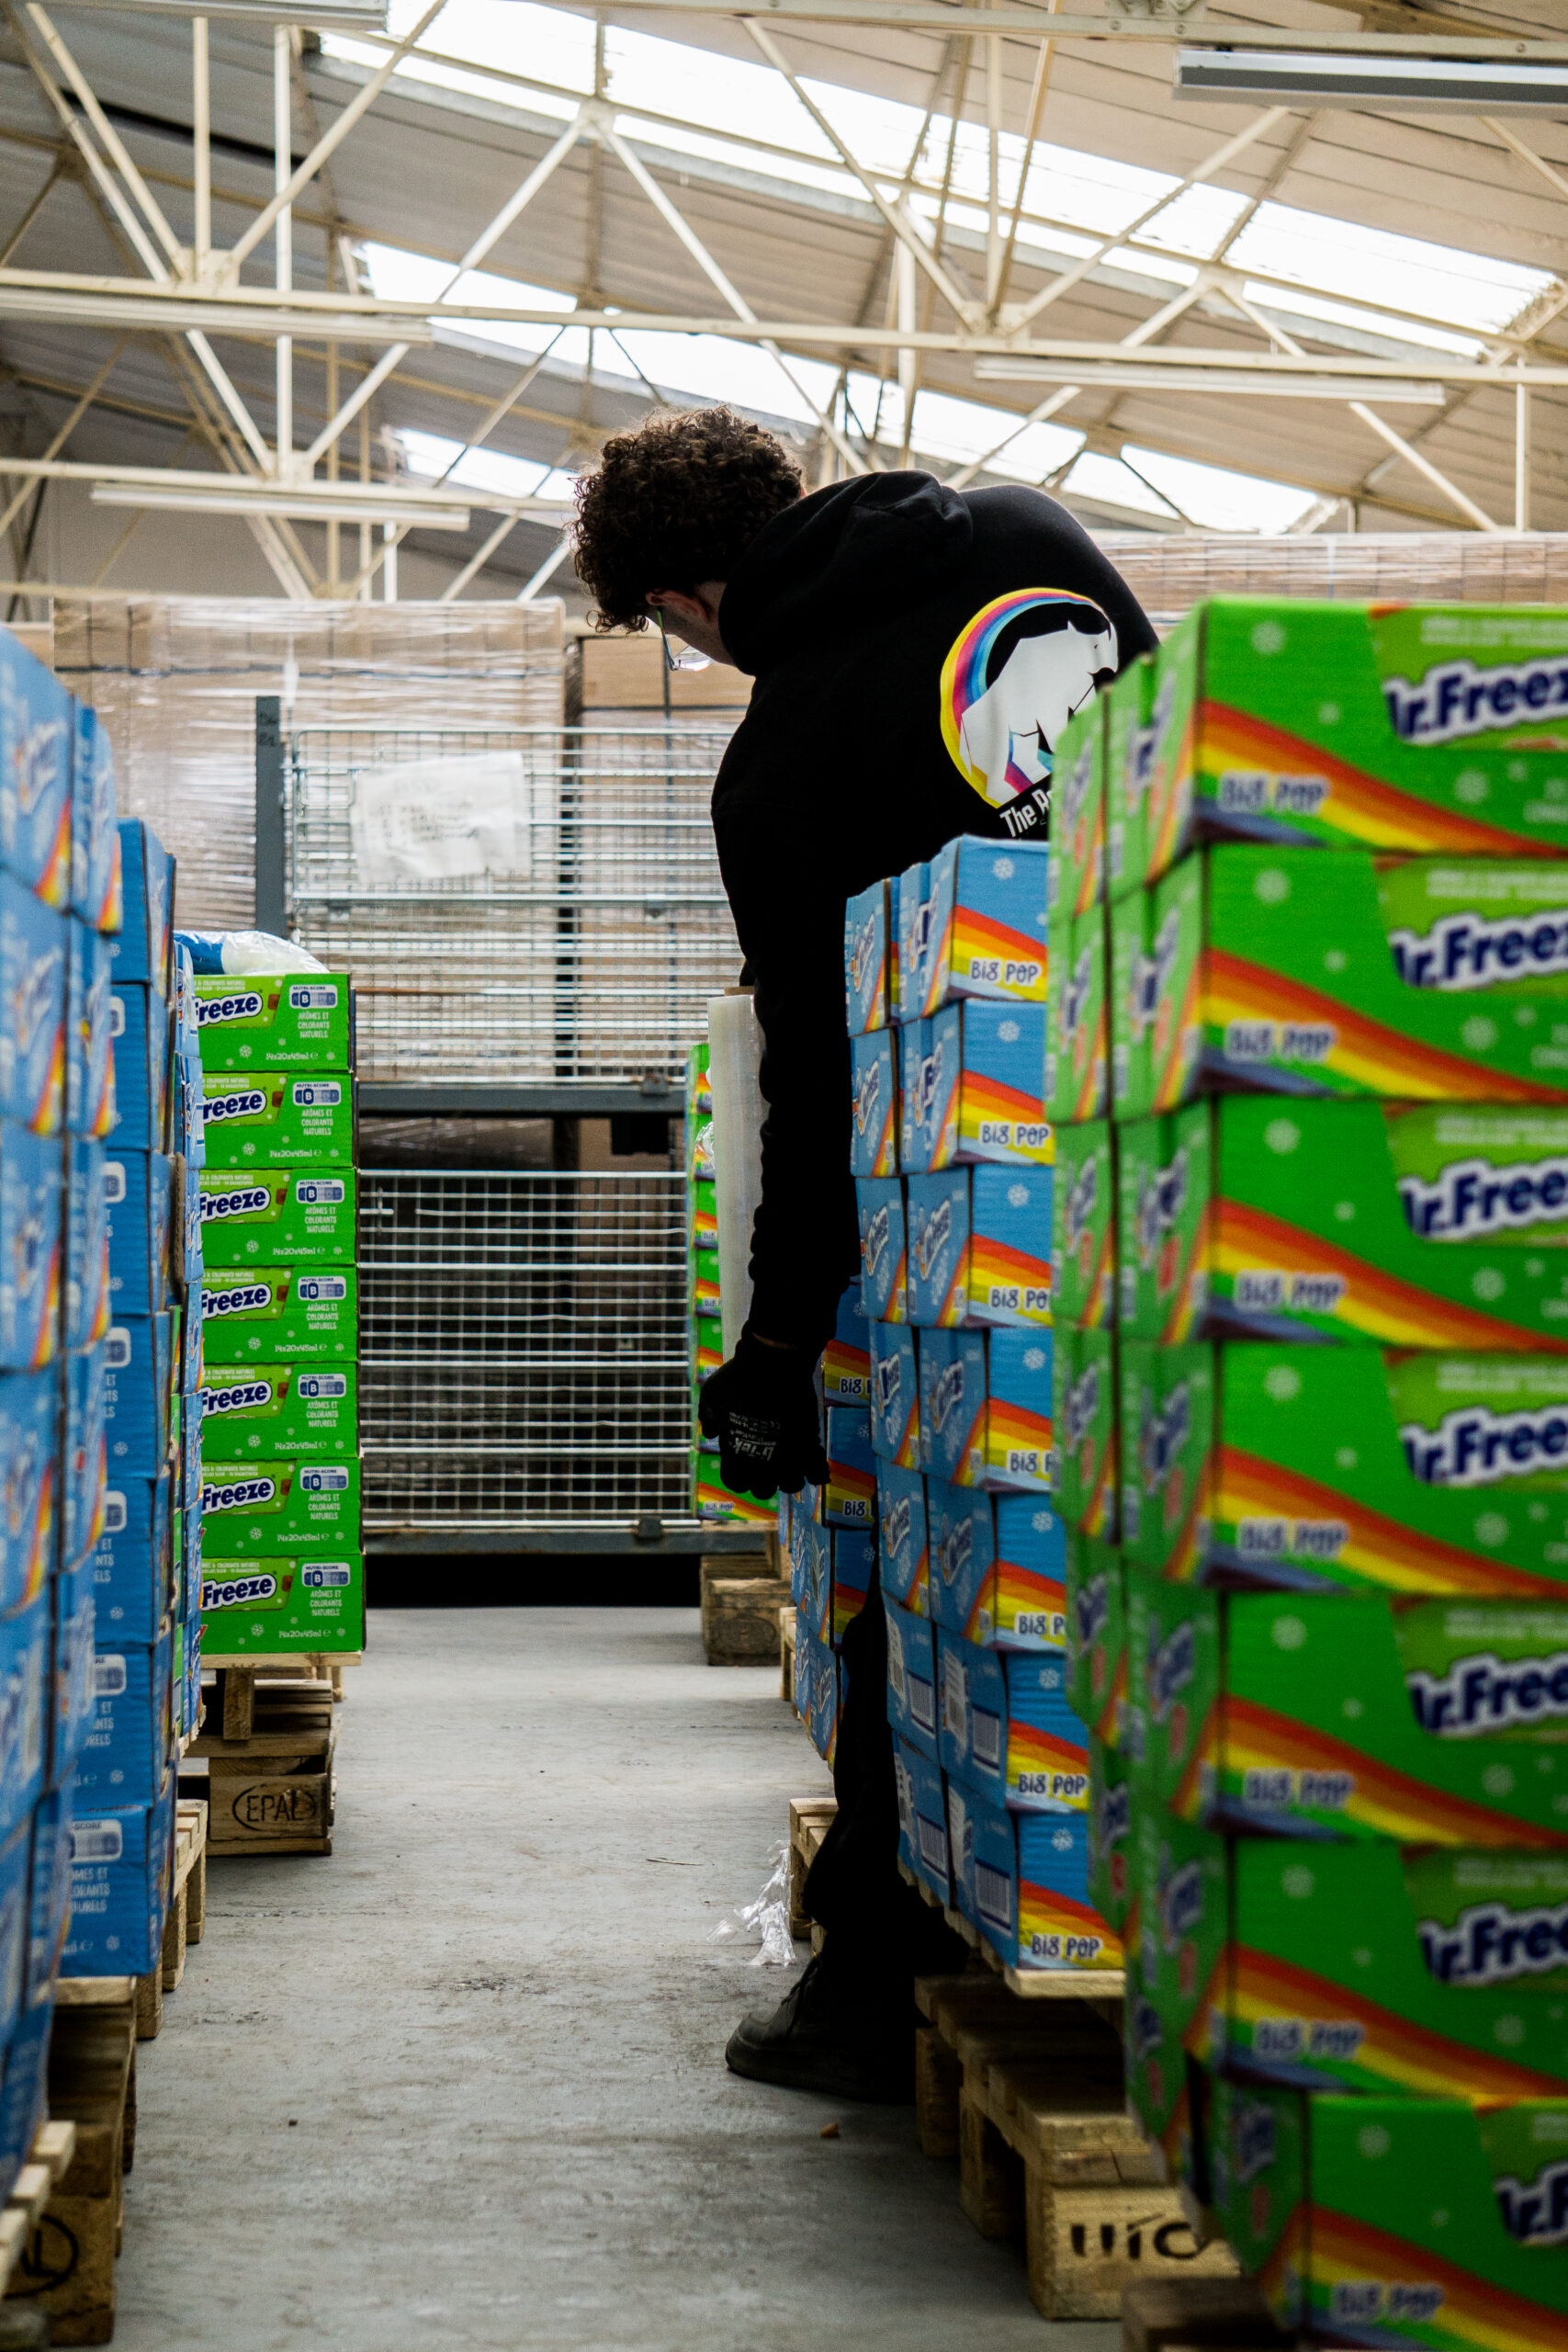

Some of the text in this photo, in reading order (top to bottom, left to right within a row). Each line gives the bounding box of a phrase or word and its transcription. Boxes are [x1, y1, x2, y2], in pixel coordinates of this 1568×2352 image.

[998, 804, 1037, 838] The
[301, 994, 309, 1004] B
[196, 995, 259, 1023] reeze
[305, 1091, 313, 1102] B
[309, 1189, 316, 1199] B
[310, 1285, 318, 1295] B
[310, 1384, 318, 1394] B
[307, 1410, 339, 1419] COLORANTS
[309, 1419, 337, 1428] NATURELS
[312, 1477, 321, 1487] B
[333, 1494, 339, 1502] ET
[310, 1511, 339, 1520] NATURELS
[314, 1574, 322, 1584] B
[203, 1575, 272, 1607] Freeze
[245, 1789, 304, 1823] EPAL
[97, 1866, 108, 1880] ET
